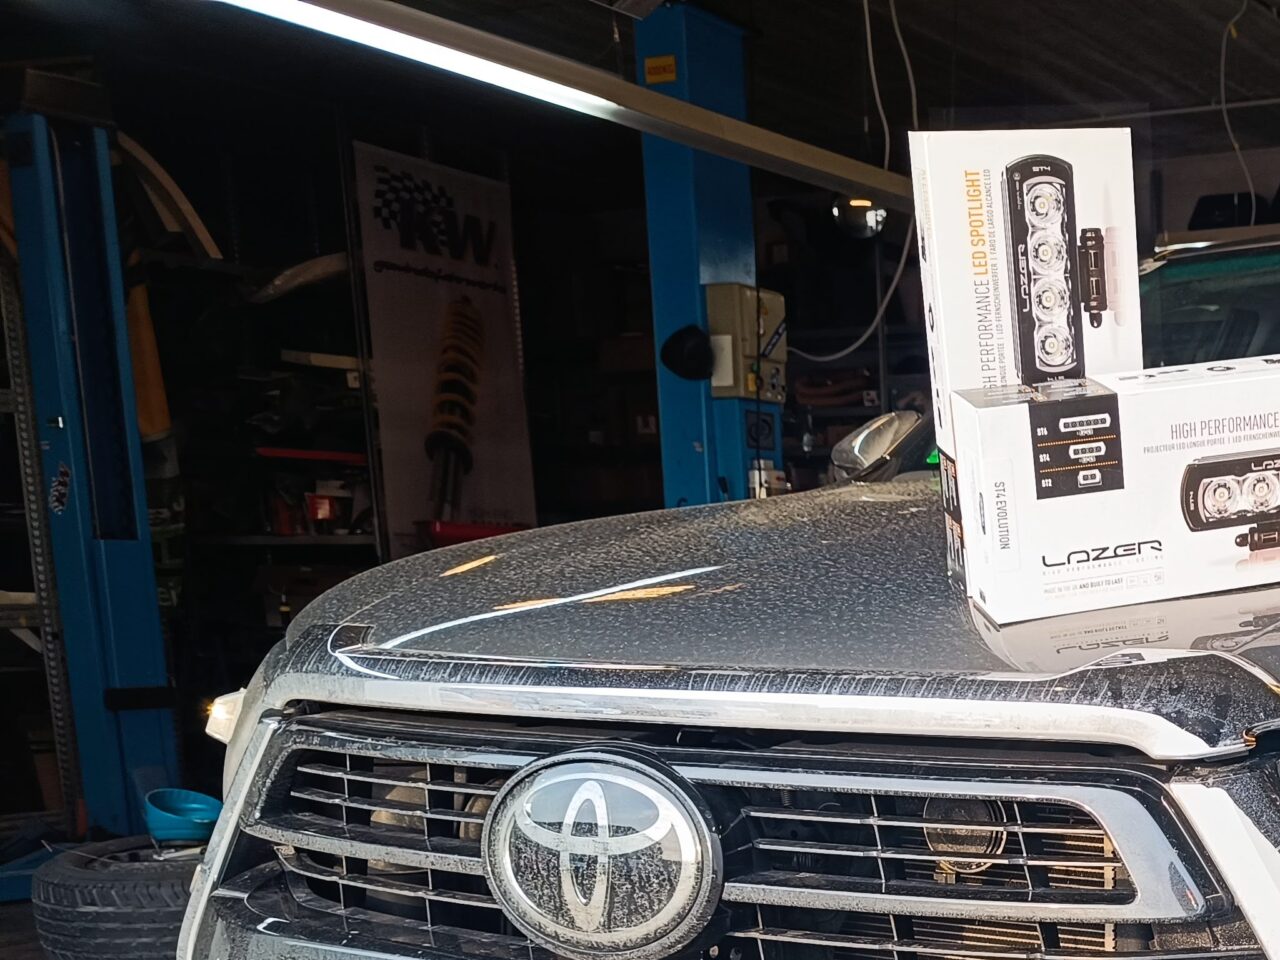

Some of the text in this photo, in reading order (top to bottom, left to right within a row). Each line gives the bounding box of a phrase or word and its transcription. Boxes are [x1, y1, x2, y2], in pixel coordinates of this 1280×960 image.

[983, 168, 991, 180] LED
[984, 181, 994, 209] ALCANCE
[964, 170, 986, 247] SPOTLIGHT
[986, 209, 995, 230] LARGO
[989, 239, 997, 257] FARO
[971, 251, 988, 276] LED
[1017, 243, 1031, 313] LAZER
[974, 279, 996, 371] PERFORMANCE
[1170, 421, 1197, 440] HIGH
[1200, 411, 1280, 437] PERFORMANCE
[1039, 453, 1051, 462] ST4
[1041, 479, 1053, 487] ST2
[994, 481, 1011, 550] ST4 EVOLUTION
[1041, 540, 1163, 567] LAZER
[1111, 577, 1123, 585] LAST
